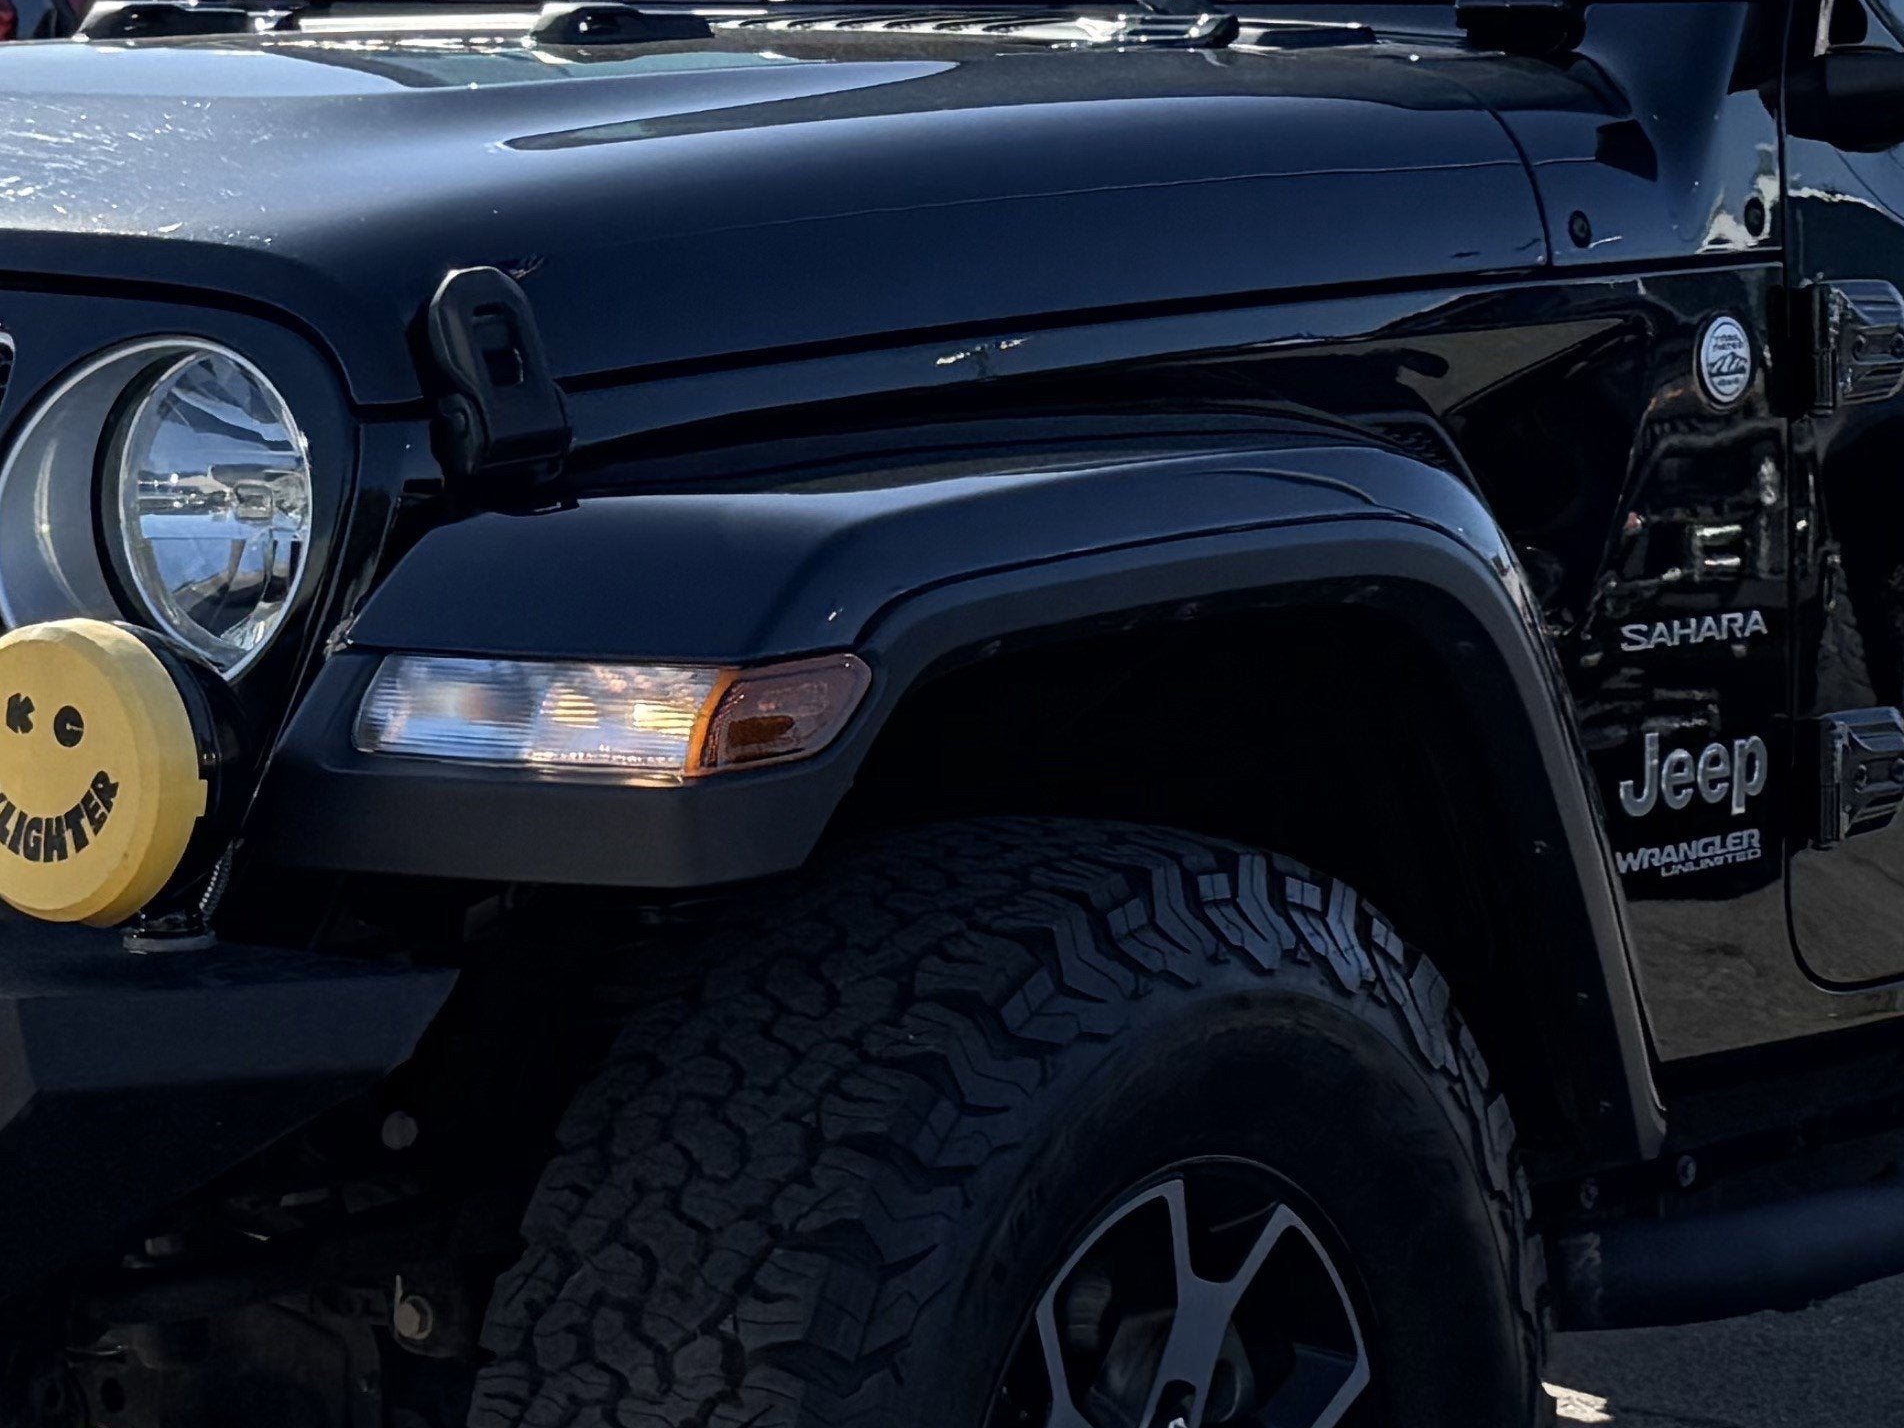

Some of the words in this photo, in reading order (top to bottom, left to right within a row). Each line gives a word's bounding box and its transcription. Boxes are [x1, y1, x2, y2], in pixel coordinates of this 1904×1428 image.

[1620, 610, 1768, 652] SAHARA
[1619, 732, 1768, 817] Jeep
[1615, 828, 1760, 874] WRANGLER
[1661, 848, 1761, 878] UNLIMITED
